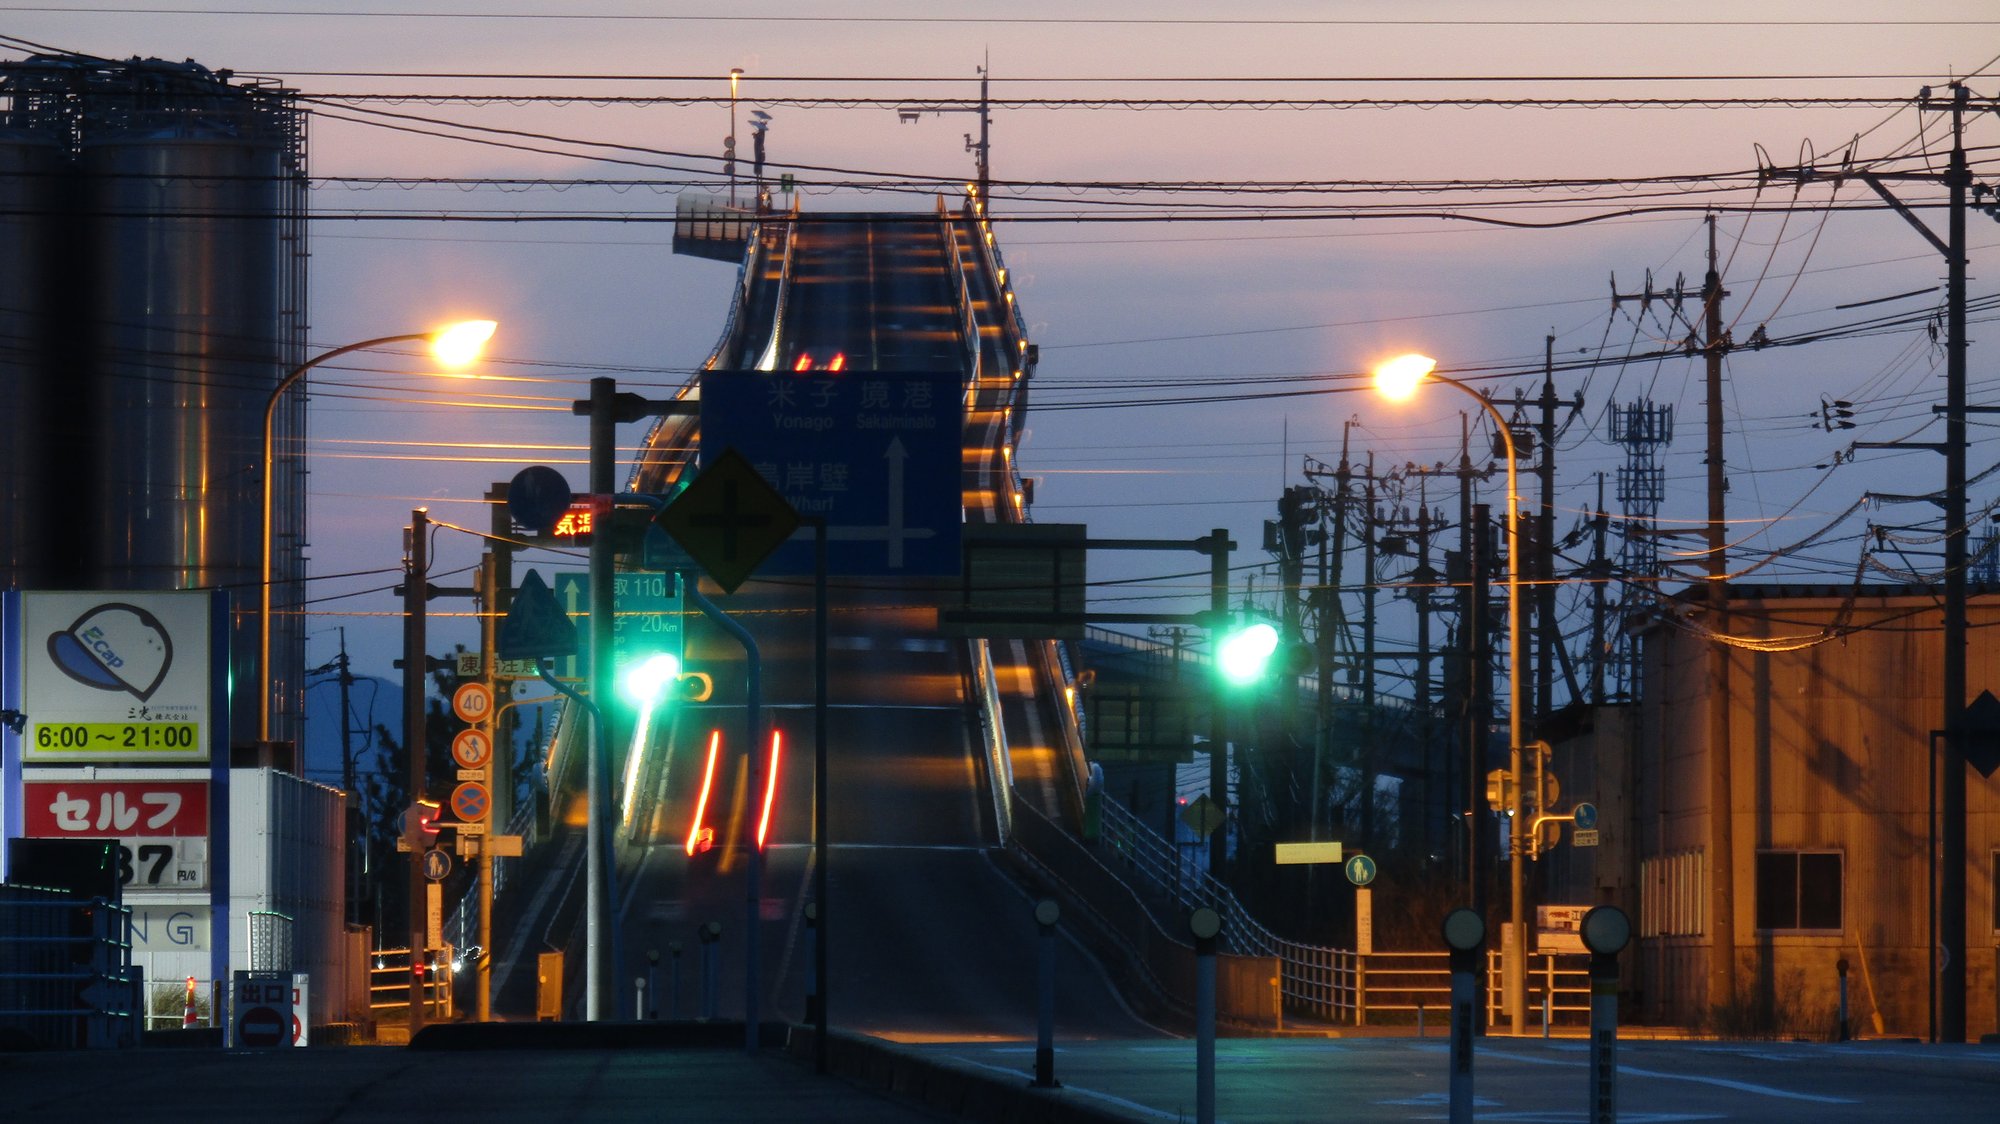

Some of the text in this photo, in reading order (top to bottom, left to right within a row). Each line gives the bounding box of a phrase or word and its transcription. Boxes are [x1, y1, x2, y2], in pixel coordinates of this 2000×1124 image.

[767, 380, 933, 409] 米子 境港
[773, 413, 833, 432] Yonago
[463, 694, 484, 711] 40
[38, 726, 88, 748] 6:00
[123, 726, 192, 748] 21:00
[49, 791, 182, 831] セルフ
[242, 984, 284, 1004] 出口
